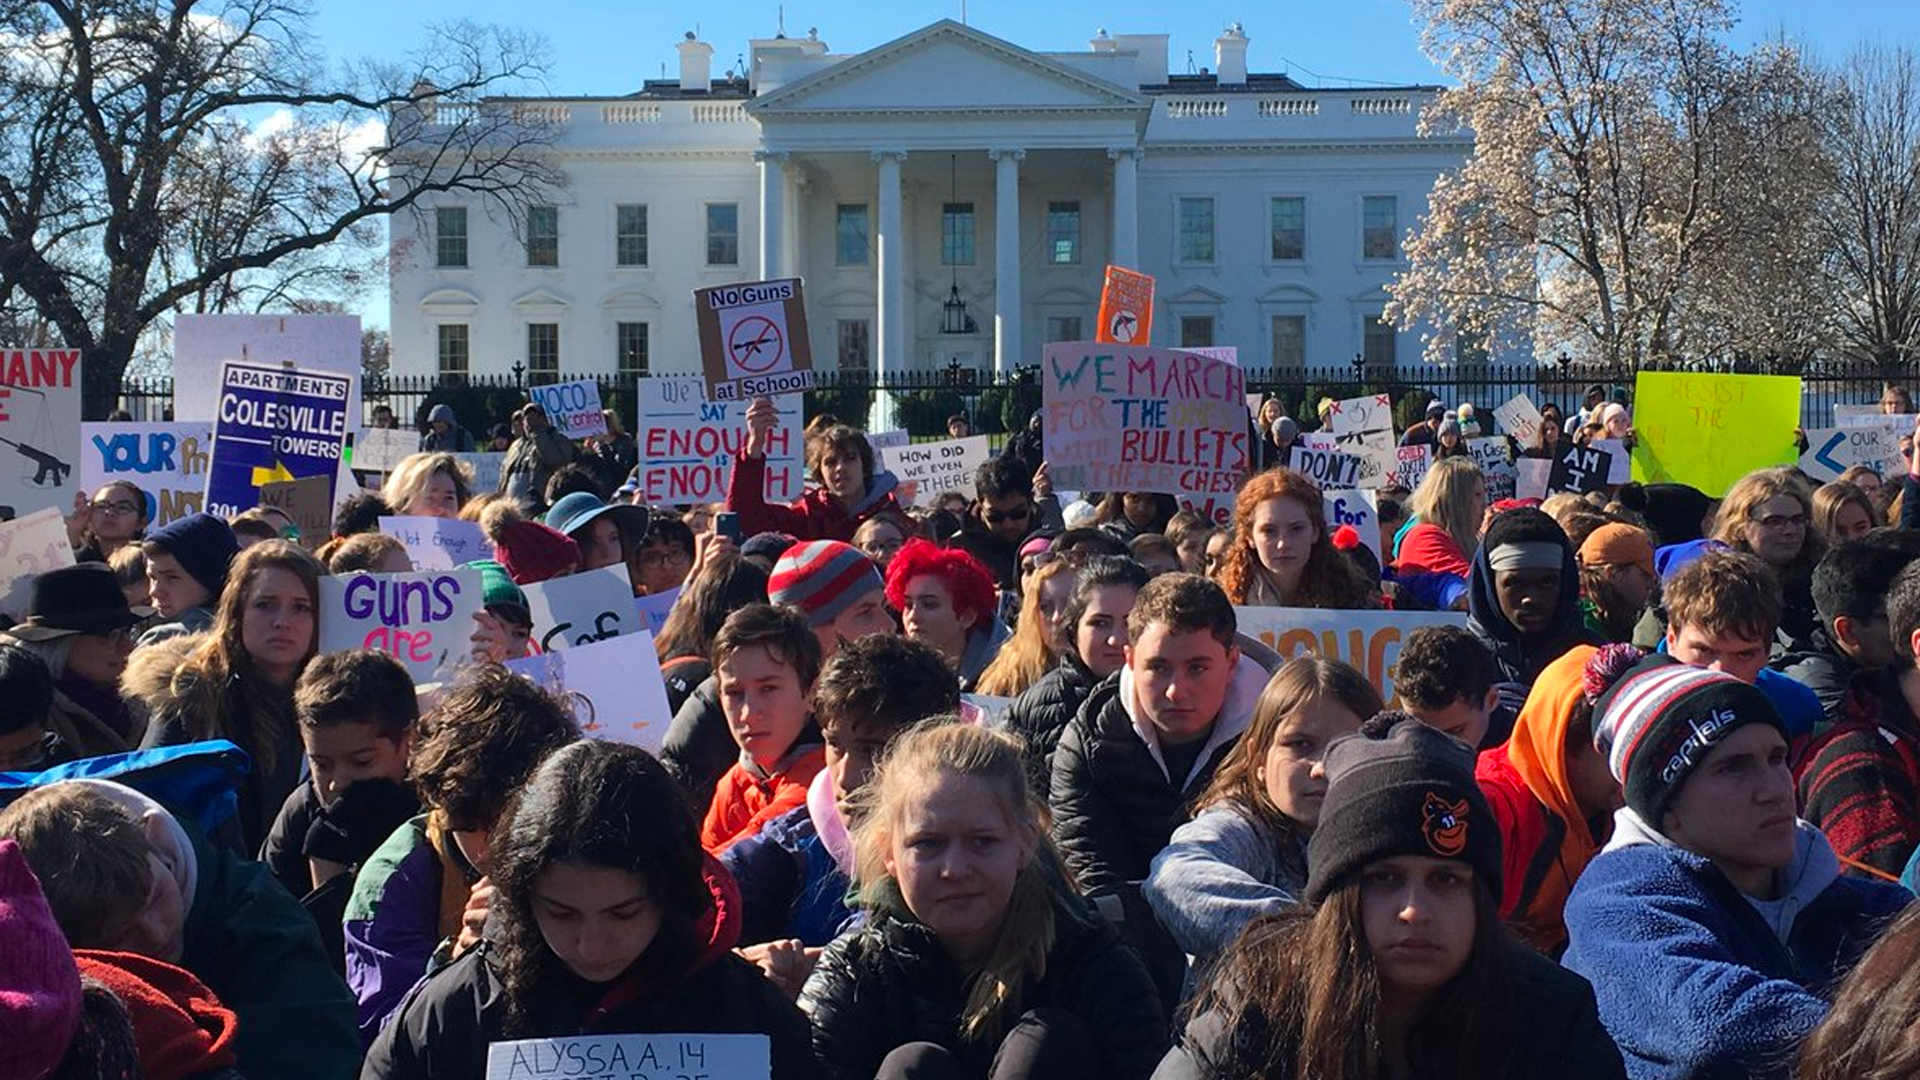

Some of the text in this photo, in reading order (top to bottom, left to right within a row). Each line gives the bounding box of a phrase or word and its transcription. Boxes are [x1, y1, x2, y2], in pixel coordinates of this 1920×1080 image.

[711, 284, 792, 307] No Guns
[0, 350, 80, 388] ANY
[1052, 355, 1117, 394] WE
[1127, 355, 1243, 407] MARCH
[228, 370, 346, 398] APARTMENTS
[717, 383, 734, 400] at
[743, 371, 813, 396] School!
[1672, 377, 1749, 403] RESIST
[220, 393, 346, 436] COLESVILLE
[700, 404, 728, 422] SAY
[1050, 396, 1110, 434] FOR
[1112, 399, 1169, 429] THE
[1689, 405, 1728, 429] THE
[271, 435, 341, 460] TOWERS
[645, 427, 790, 458] ENOUH
[1121, 427, 1247, 472] BULLETS
[1851, 431, 1880, 446] OUR
[92, 433, 177, 474] YOUR
[715, 455, 728, 465] IS
[899, 446, 965, 463] HOW DID
[1301, 451, 1362, 484] DON'T
[1563, 449, 1600, 473] AM
[645, 464, 790, 500] ENOUH
[904, 461, 963, 477] WE EVEN
[1564, 468, 1586, 493] I
[1334, 498, 1367, 526] for
[364, 626, 433, 663] are
[1662, 709, 1737, 784] capitals
[508, 1042, 630, 1079] ALYSSA
[679, 1042, 705, 1069] 14
